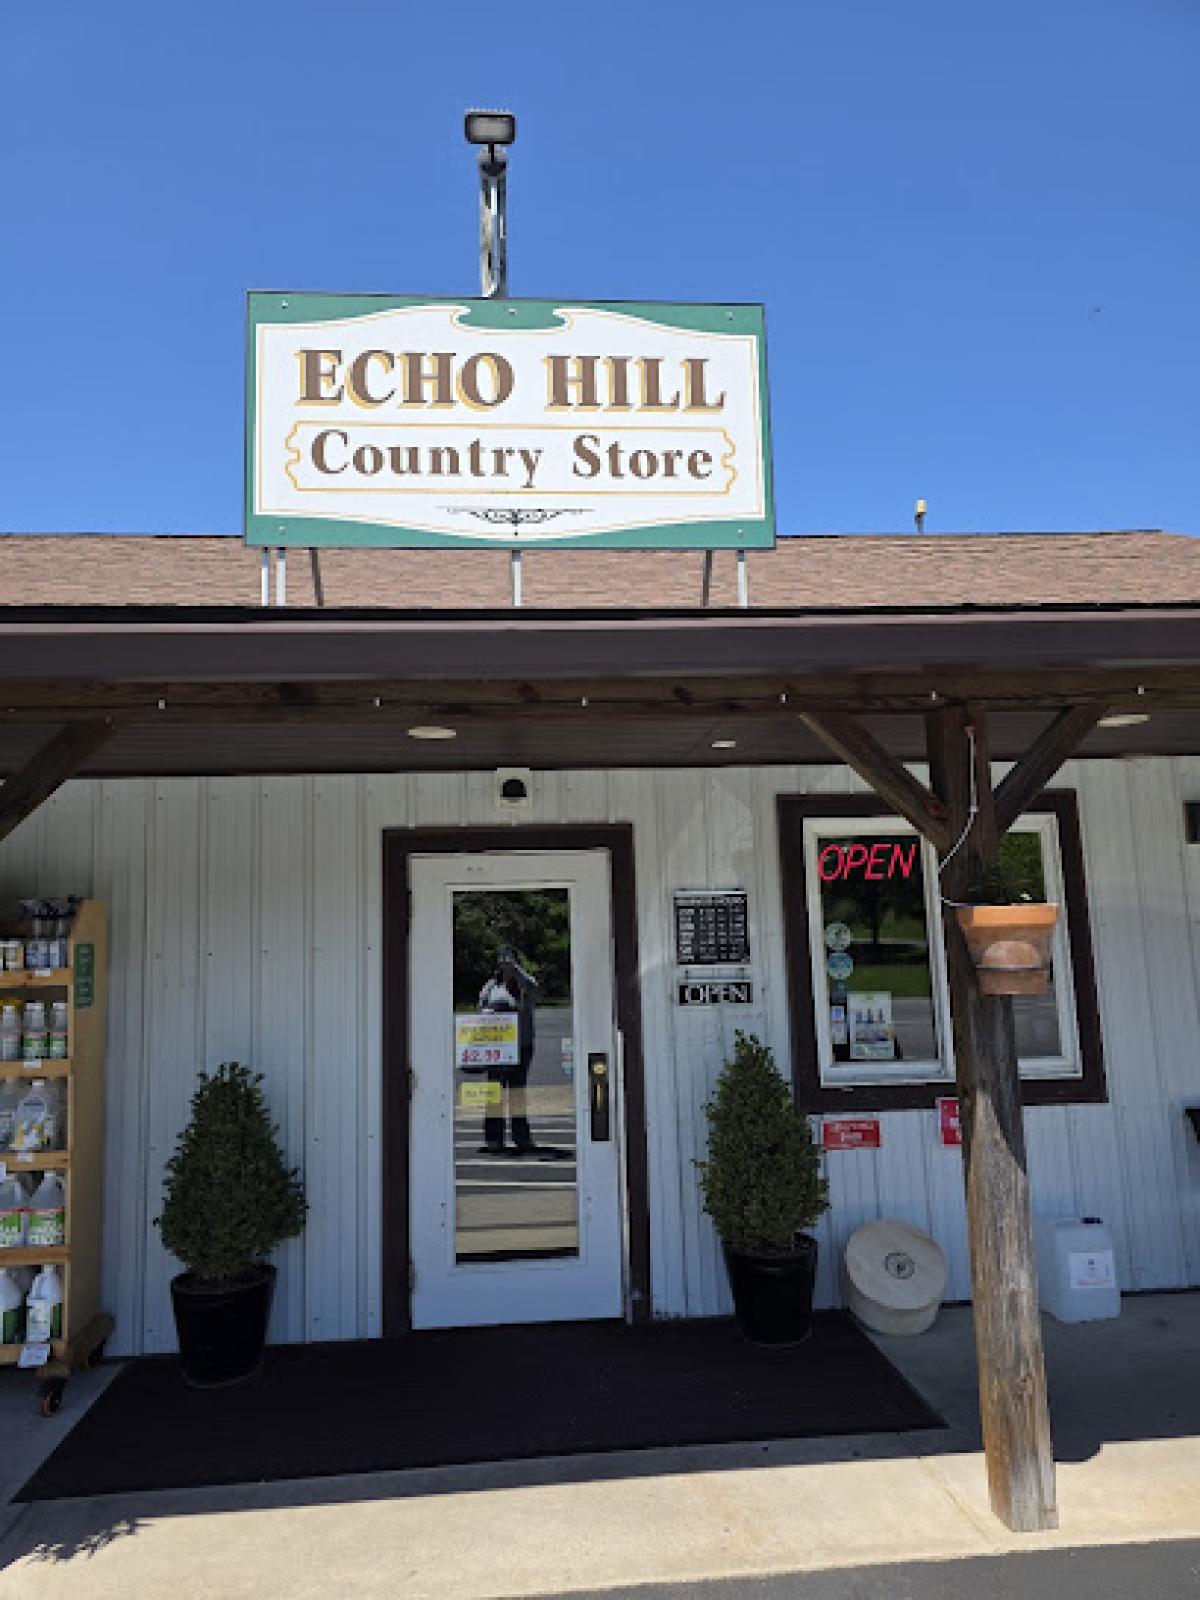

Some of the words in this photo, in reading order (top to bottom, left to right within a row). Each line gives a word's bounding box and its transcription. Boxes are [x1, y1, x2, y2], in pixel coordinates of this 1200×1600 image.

[294, 348, 515, 411] ECHO
[543, 355, 726, 412] HILL
[311, 429, 543, 489] Country
[572, 434, 713, 479] Store
[818, 843, 916, 880] OPEN
